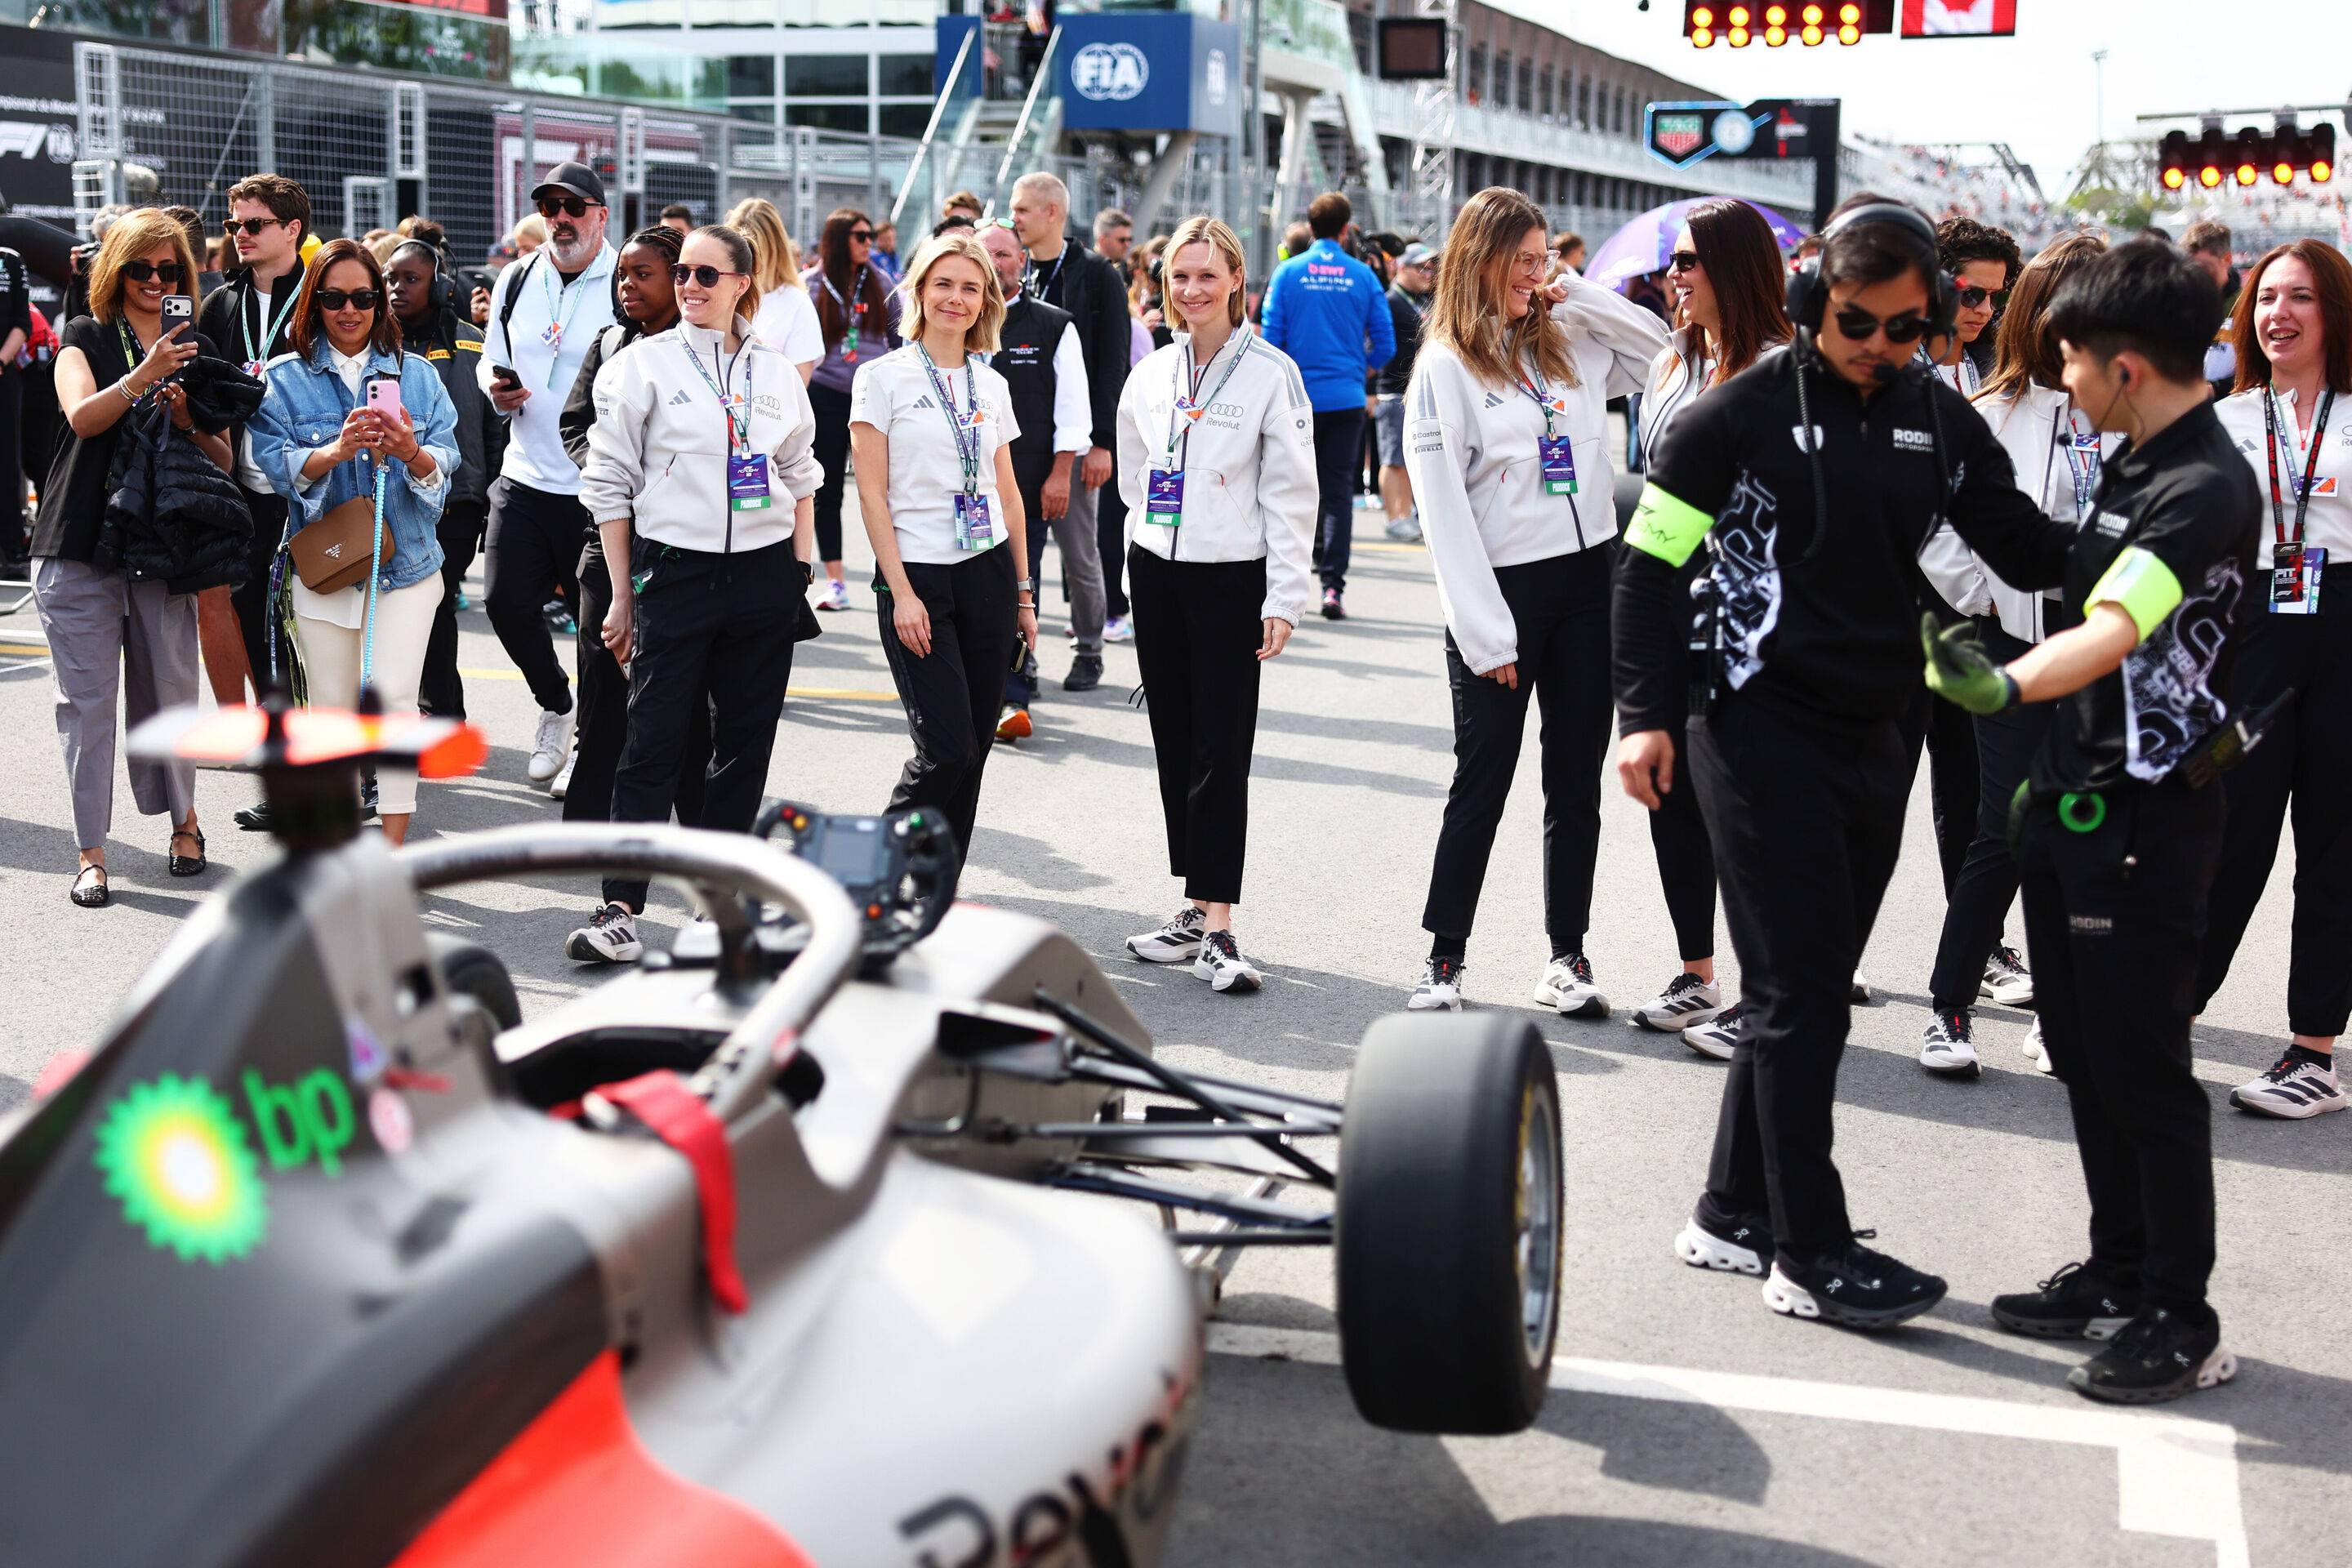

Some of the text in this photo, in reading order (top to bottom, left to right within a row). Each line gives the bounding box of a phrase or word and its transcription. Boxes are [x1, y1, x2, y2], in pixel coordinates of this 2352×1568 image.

[1076, 54, 1143, 89] FIA
[1299, 275, 1354, 287] ALPINE
[755, 407, 782, 421] Revolut
[1206, 417, 1241, 430] Revolut
[1893, 442, 1935, 452] MOTORSPO
[2274, 568, 2297, 578] PIT
[245, 1067, 356, 1177] bp
